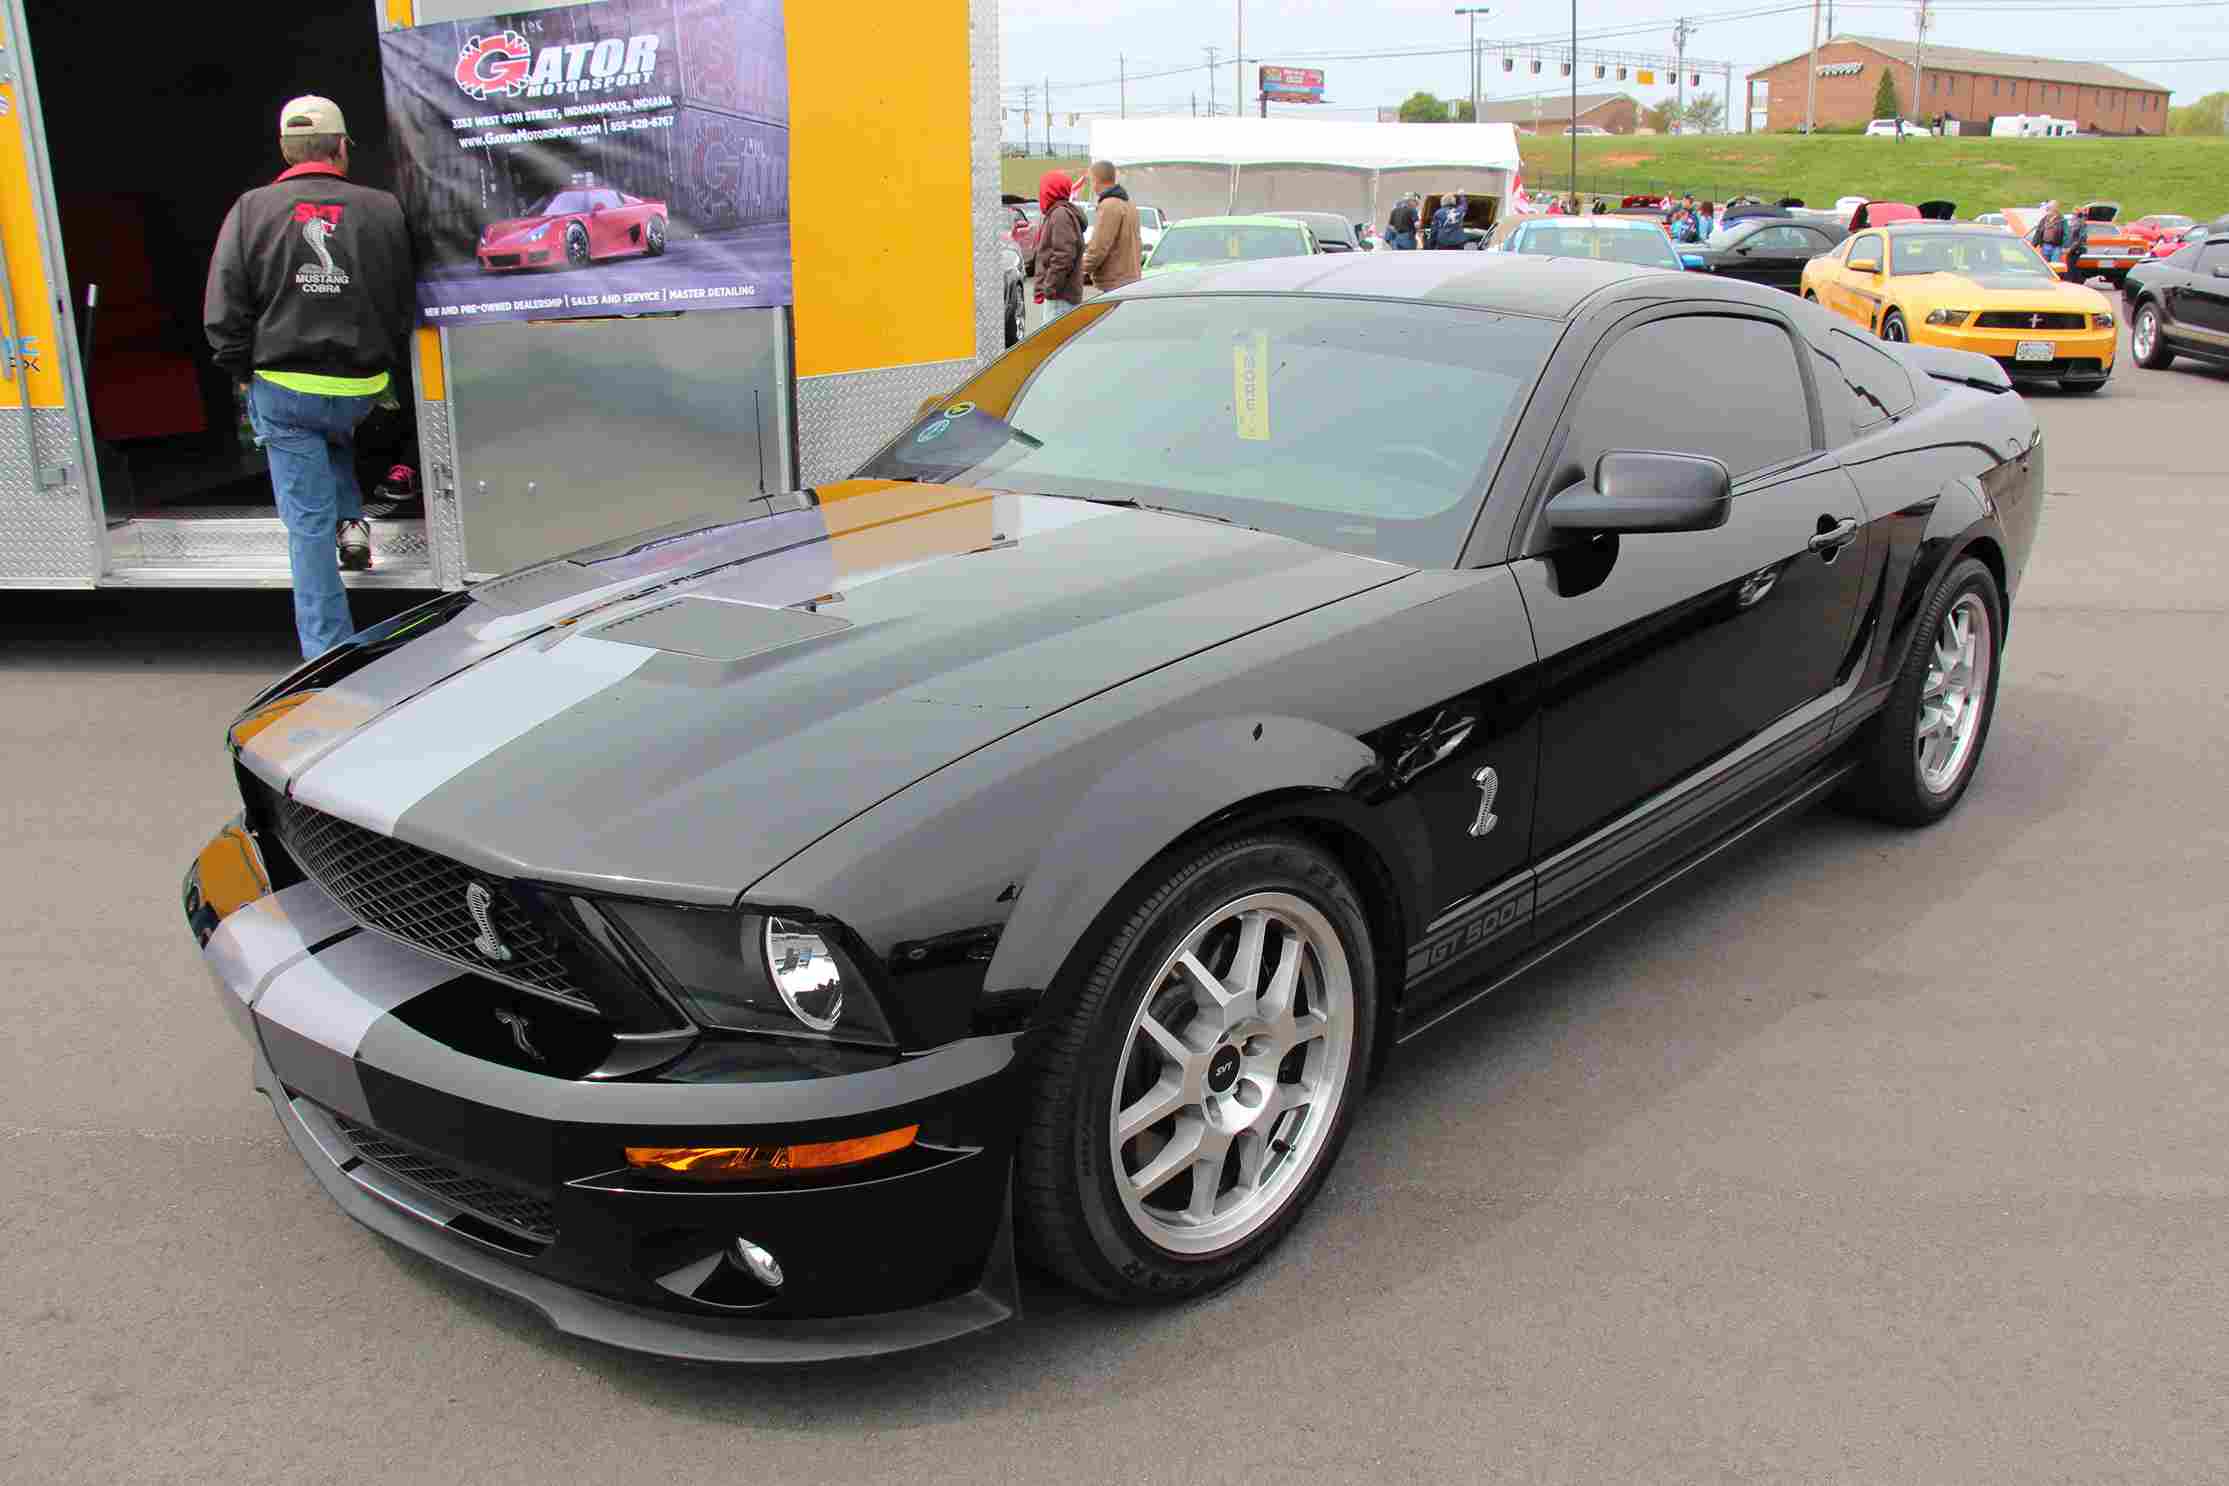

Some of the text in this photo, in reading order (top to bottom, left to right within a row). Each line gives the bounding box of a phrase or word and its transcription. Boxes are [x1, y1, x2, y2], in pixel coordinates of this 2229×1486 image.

[455, 31, 659, 100] GATOR
[526, 71, 655, 97] MOTORSPORT
[475, 114, 500, 127] WEST
[563, 100, 631, 118] INDIANAPOLIS,
[633, 94, 673, 110] INDIANA
[295, 273, 350, 284] MUSTANG
[302, 284, 342, 294] COBRA
[441, 305, 458, 316] AND
[460, 301, 512, 316] PRE-OWNED
[513, 296, 562, 312] DEALERSHIP
[571, 294, 599, 306] SALES
[601, 292, 621, 305] AND
[623, 289, 660, 304] SERVICE
[669, 286, 706, 300] MASTER
[708, 284, 756, 299] DETAILING
[1215, 1060, 1232, 1077] SVT
